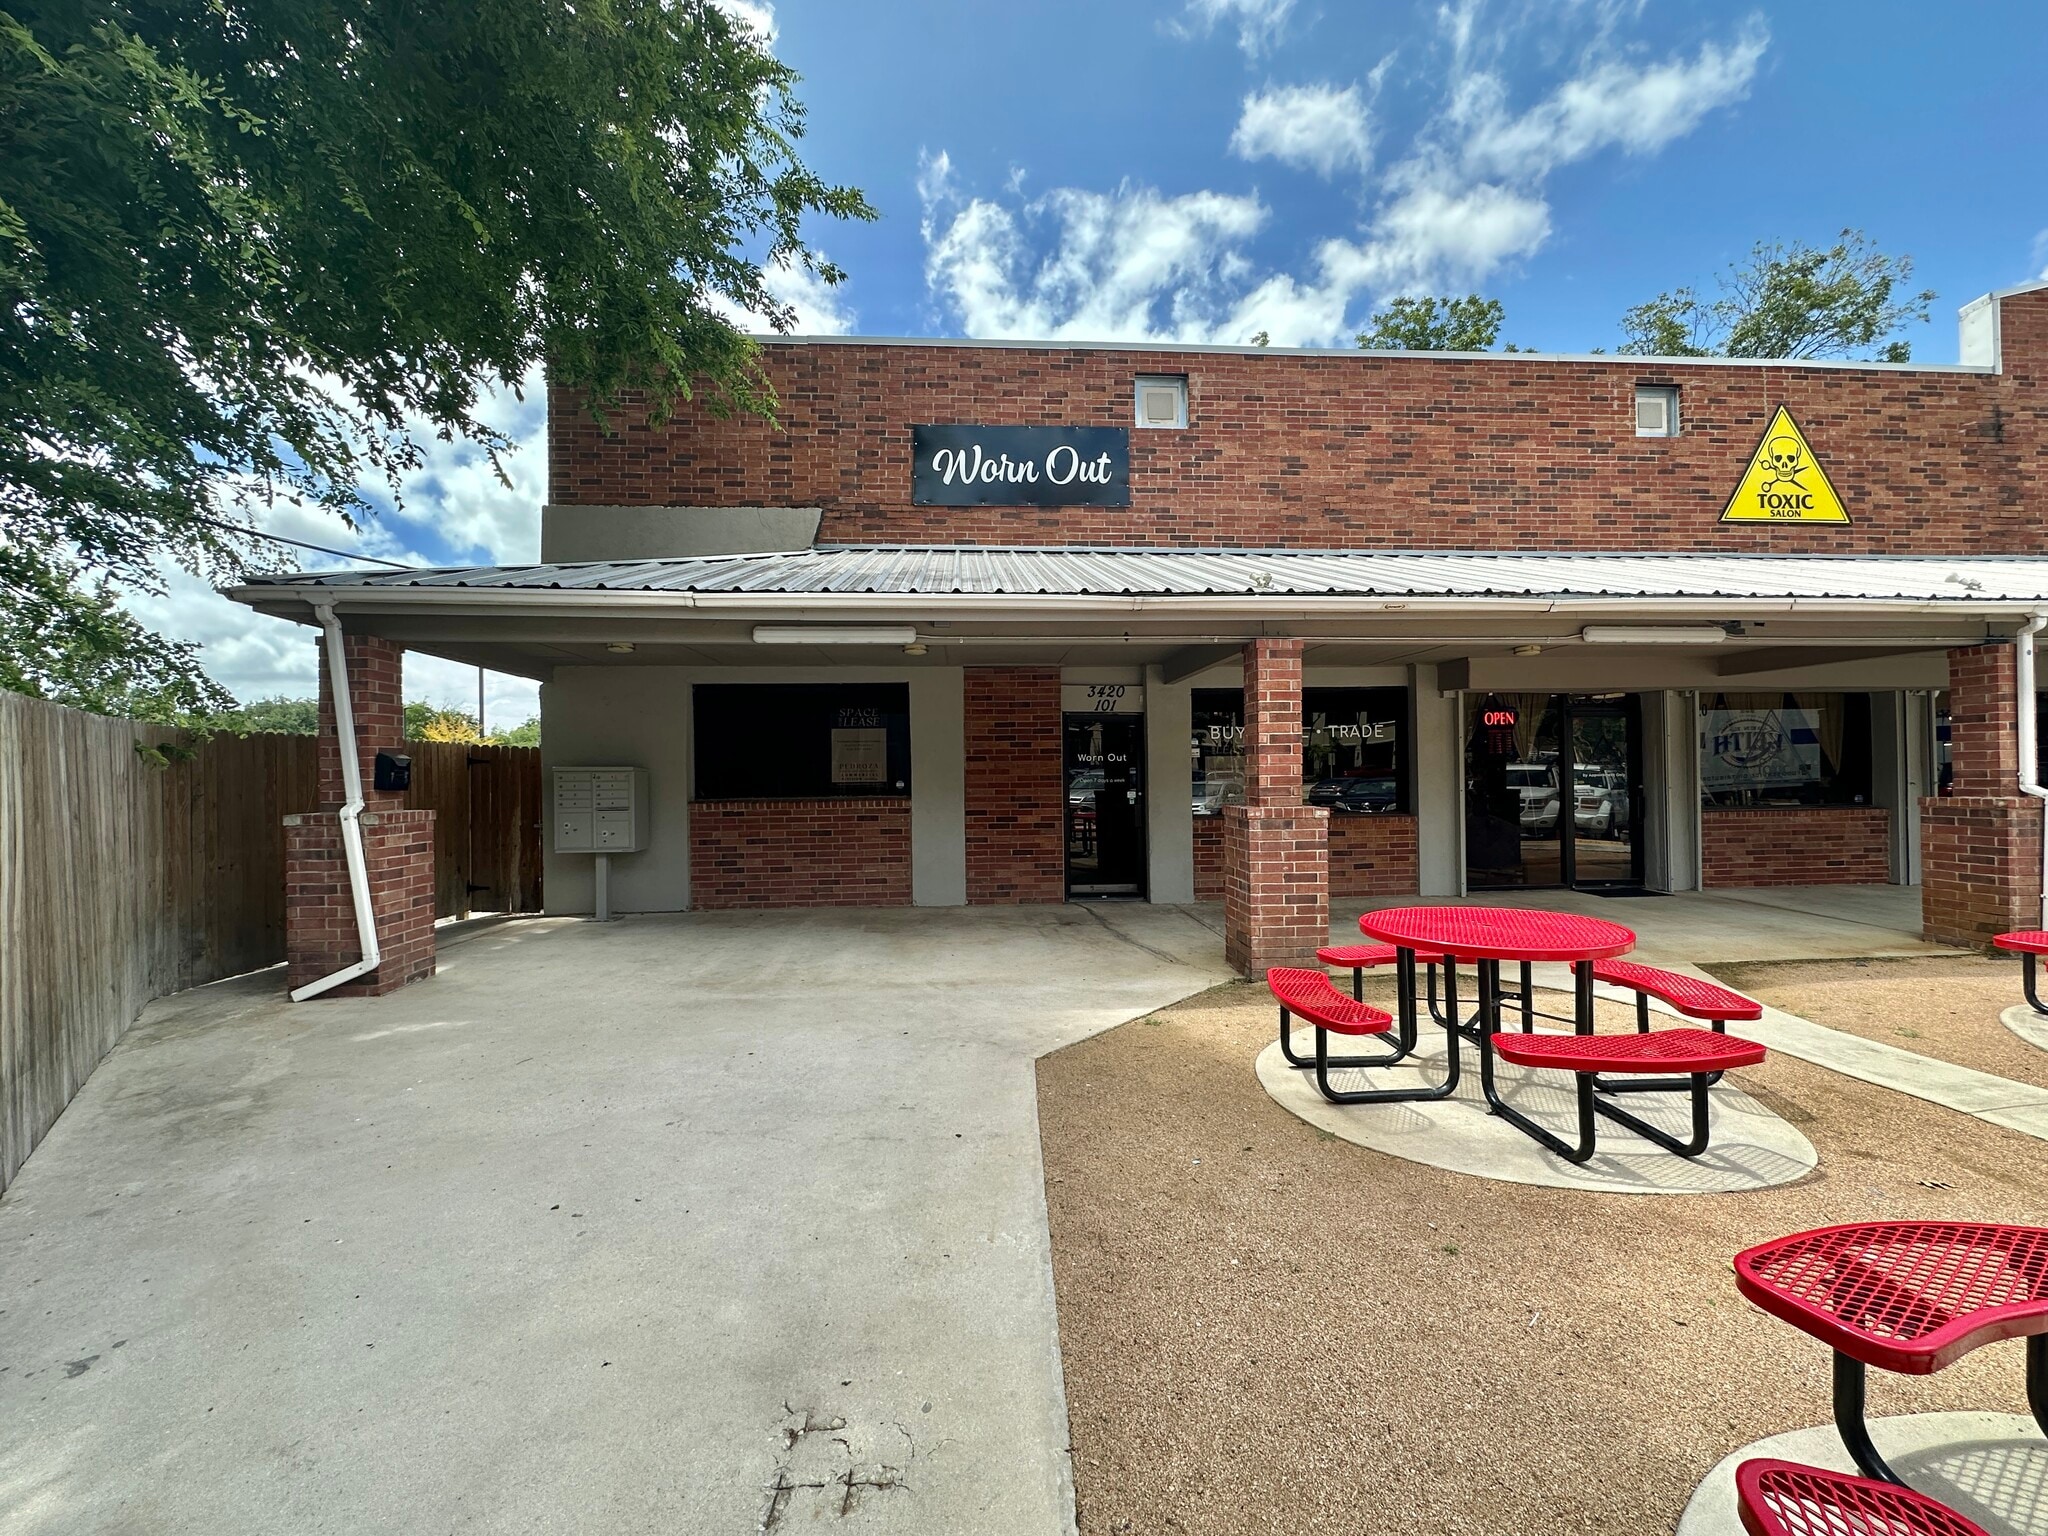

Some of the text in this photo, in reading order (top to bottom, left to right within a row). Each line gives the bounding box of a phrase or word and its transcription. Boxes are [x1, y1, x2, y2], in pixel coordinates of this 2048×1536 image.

[932, 445, 1113, 486] Worn Out
[1757, 494, 1814, 509] TOXIC
[1087, 685, 1125, 698] 3420
[1094, 699, 1117, 711] 101
[839, 708, 879, 717] SPACE
[1484, 711, 1515, 726] OPEN
[843, 717, 881, 727] LEASE
[1210, 724, 1385, 740] BUY TRADE
[1077, 753, 1127, 762] Worn Out
